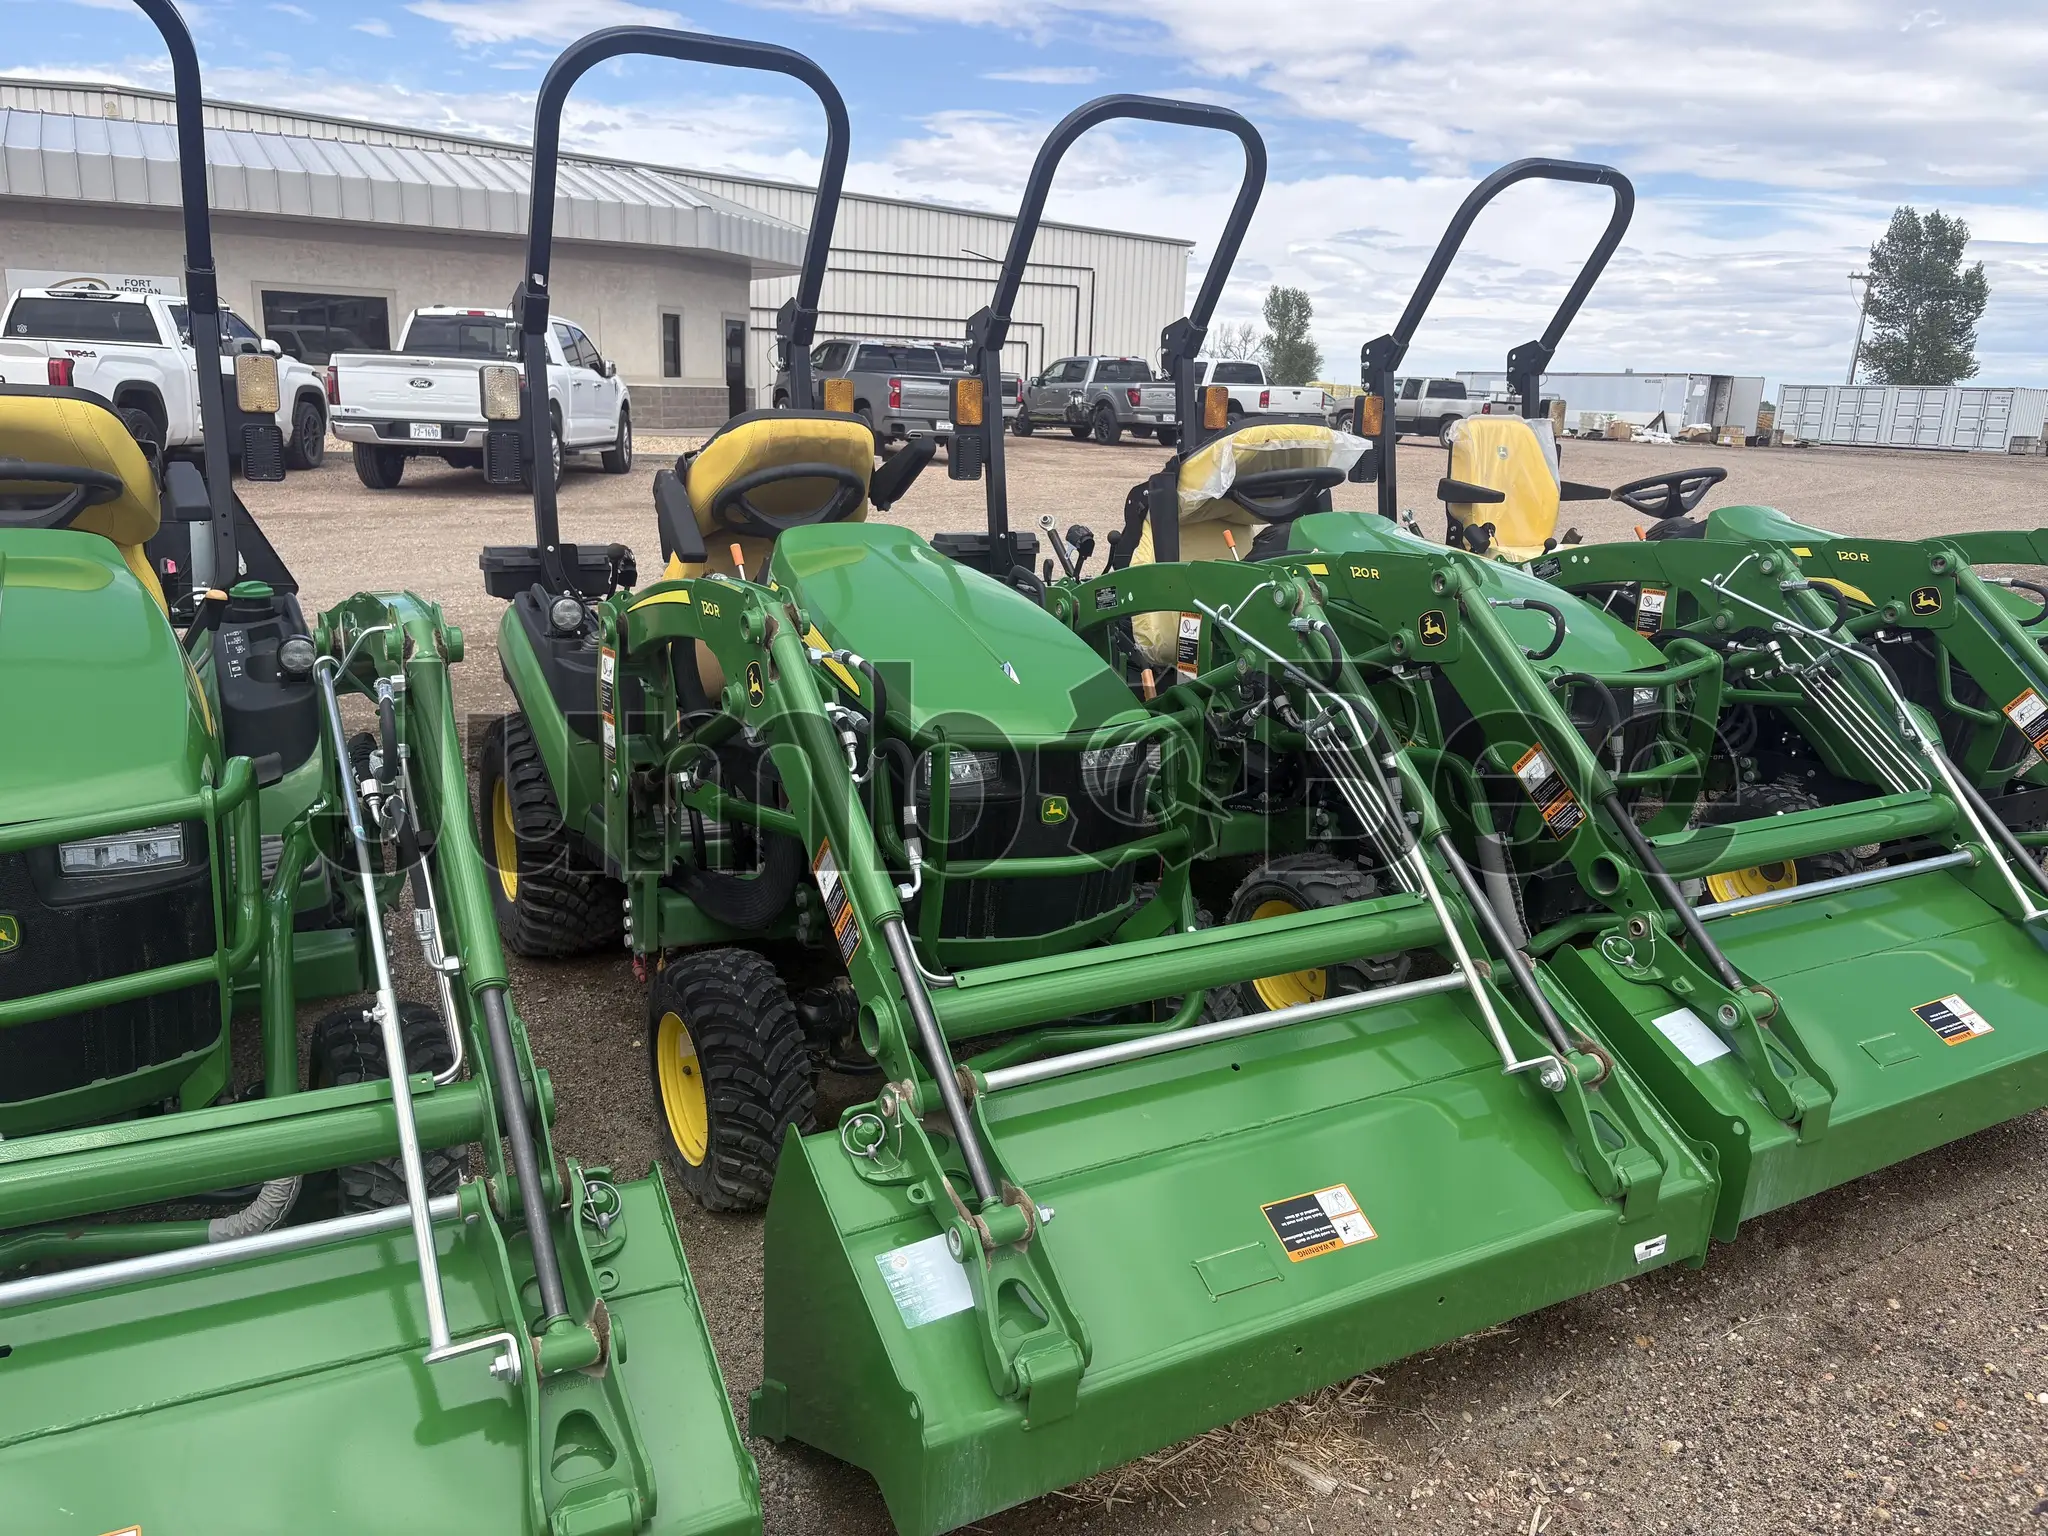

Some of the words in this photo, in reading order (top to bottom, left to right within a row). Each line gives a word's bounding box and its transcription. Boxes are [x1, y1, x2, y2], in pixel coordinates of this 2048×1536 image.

[124, 278, 151, 287] FORT
[1837, 551, 1858, 562] 120
[1860, 553, 1870, 562] R
[1350, 566, 1370, 579] 120
[1371, 568, 1380, 580] R
[701, 600, 714, 617] 120
[713, 604, 721, 620] R
[1298, 1244, 1330, 1257] WARNING
